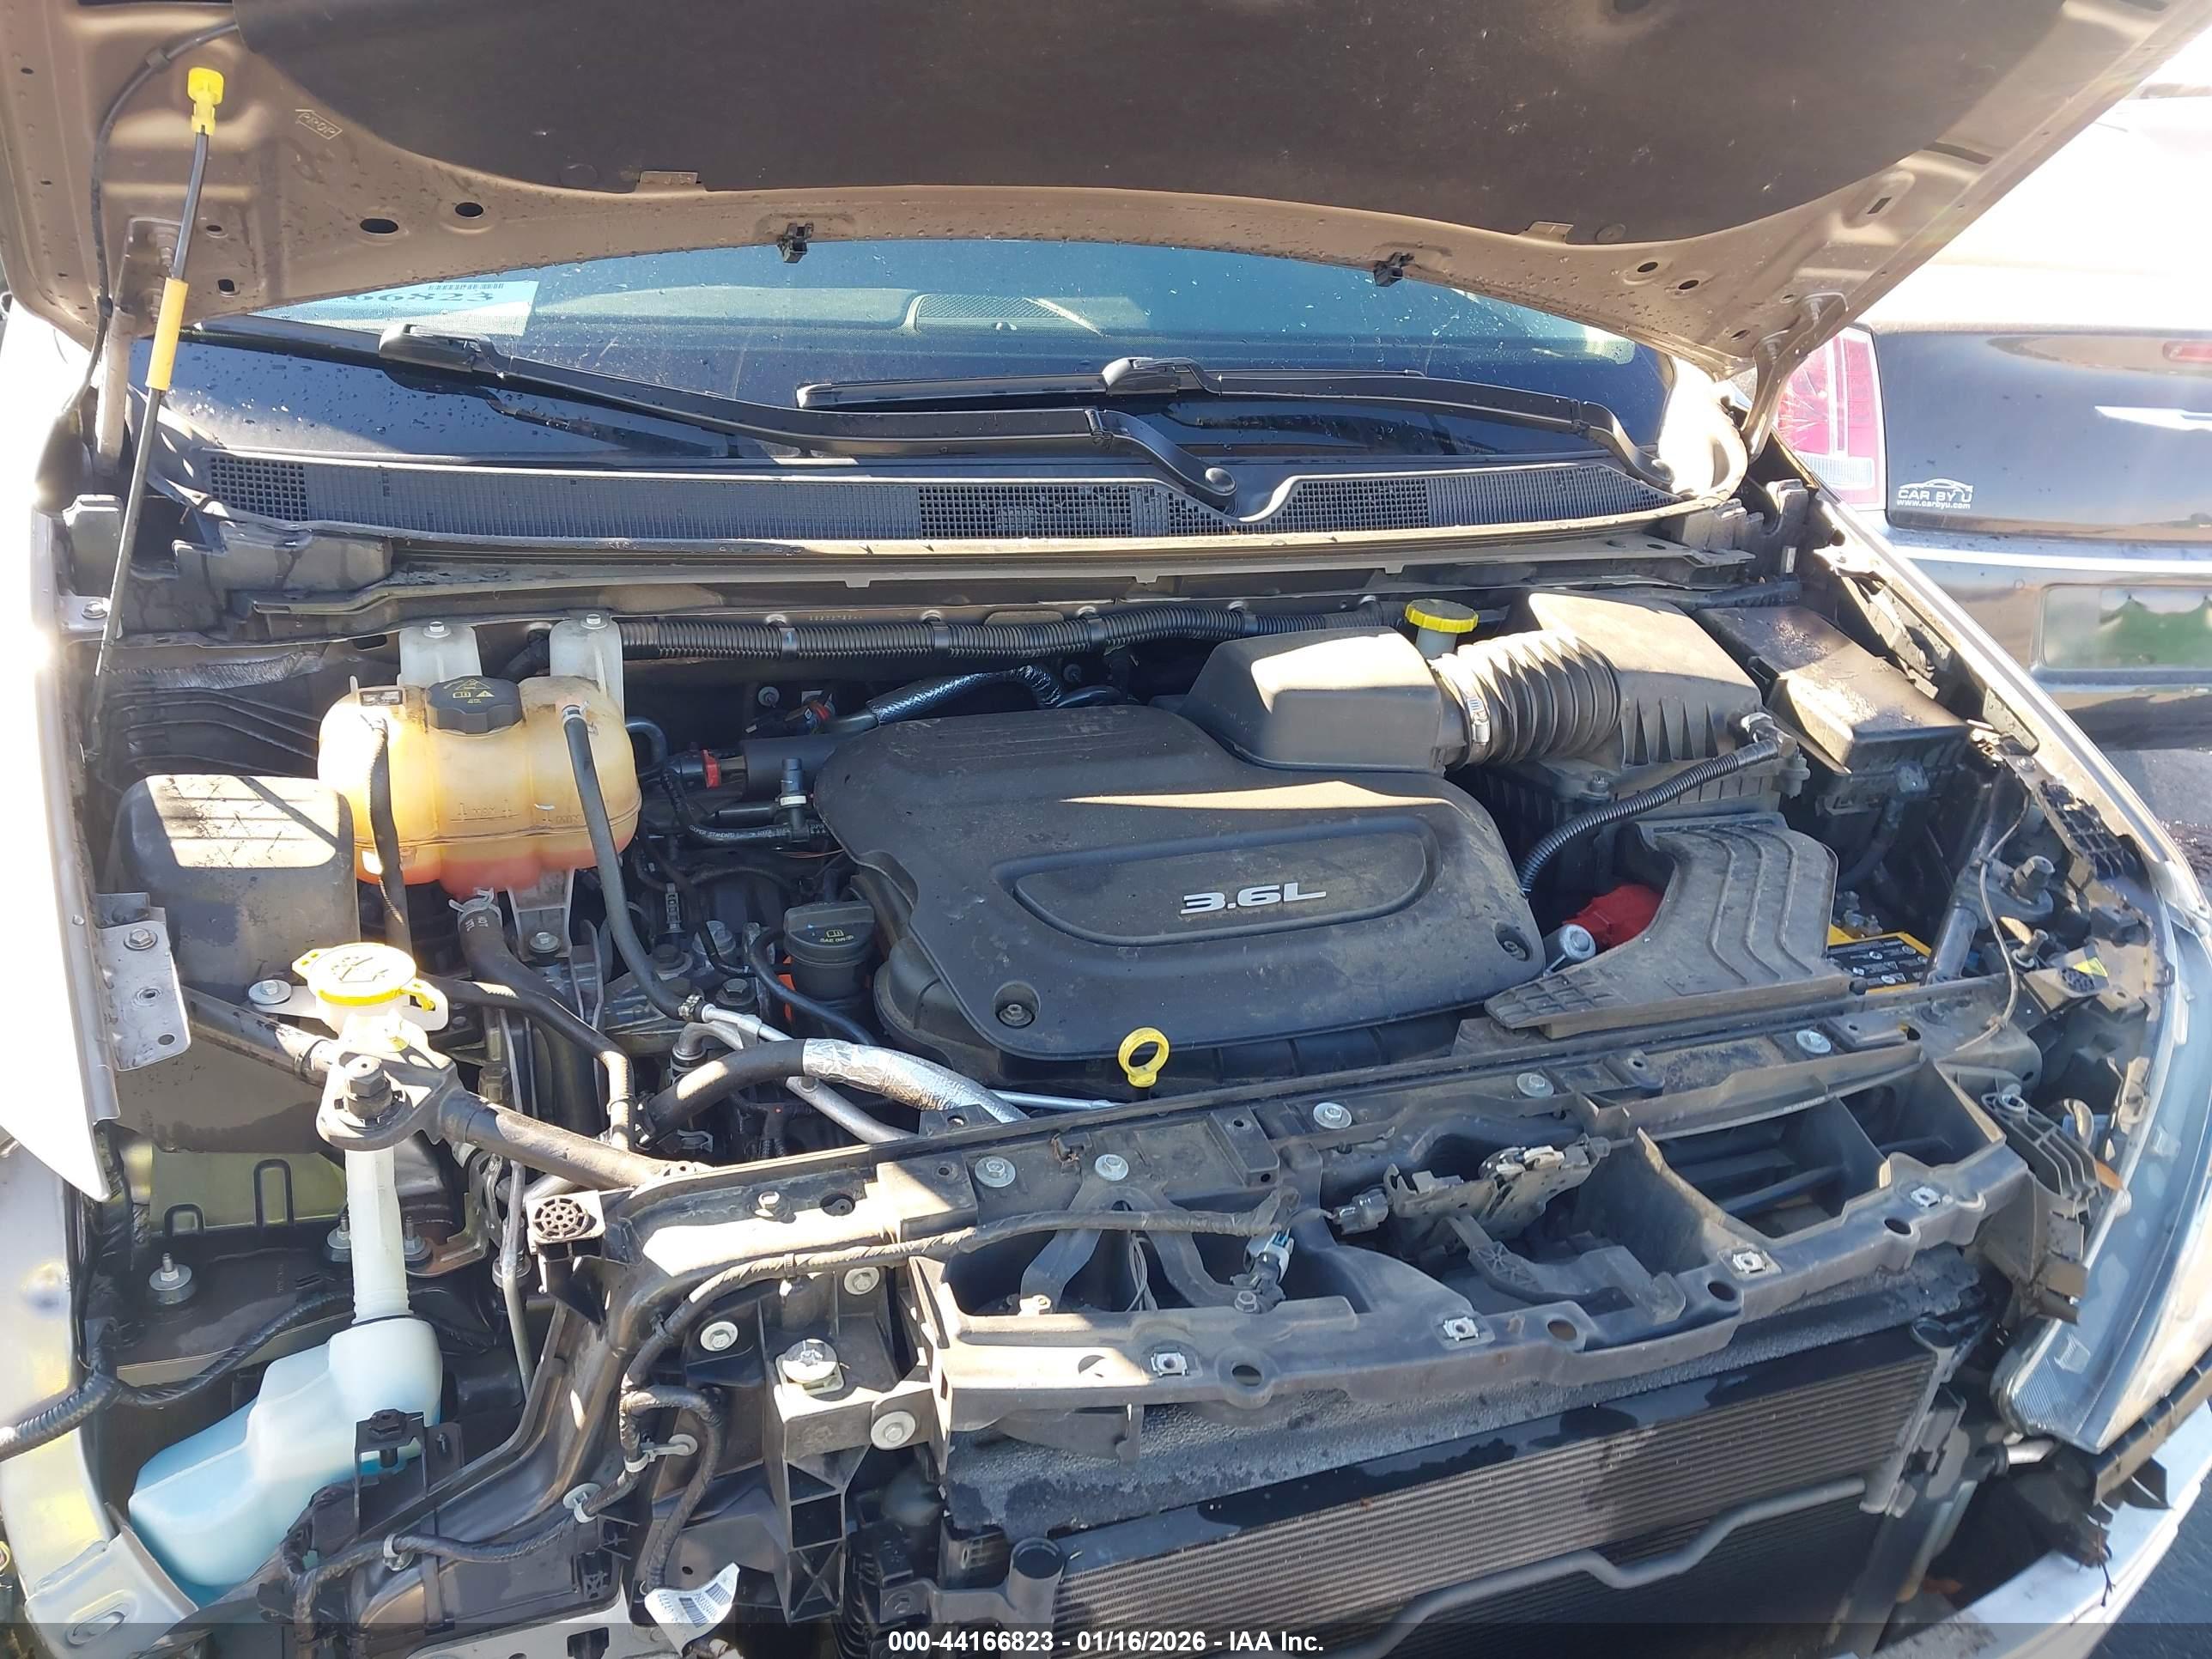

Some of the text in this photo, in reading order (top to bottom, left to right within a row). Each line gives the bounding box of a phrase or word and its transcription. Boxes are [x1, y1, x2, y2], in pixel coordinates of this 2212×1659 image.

[297, 112, 336, 134] PROP
[1896, 499, 1971, 510] www.carbyu.com
[1898, 489, 1972, 503] CAR BY U
[1180, 882, 1327, 915] 3.6L
